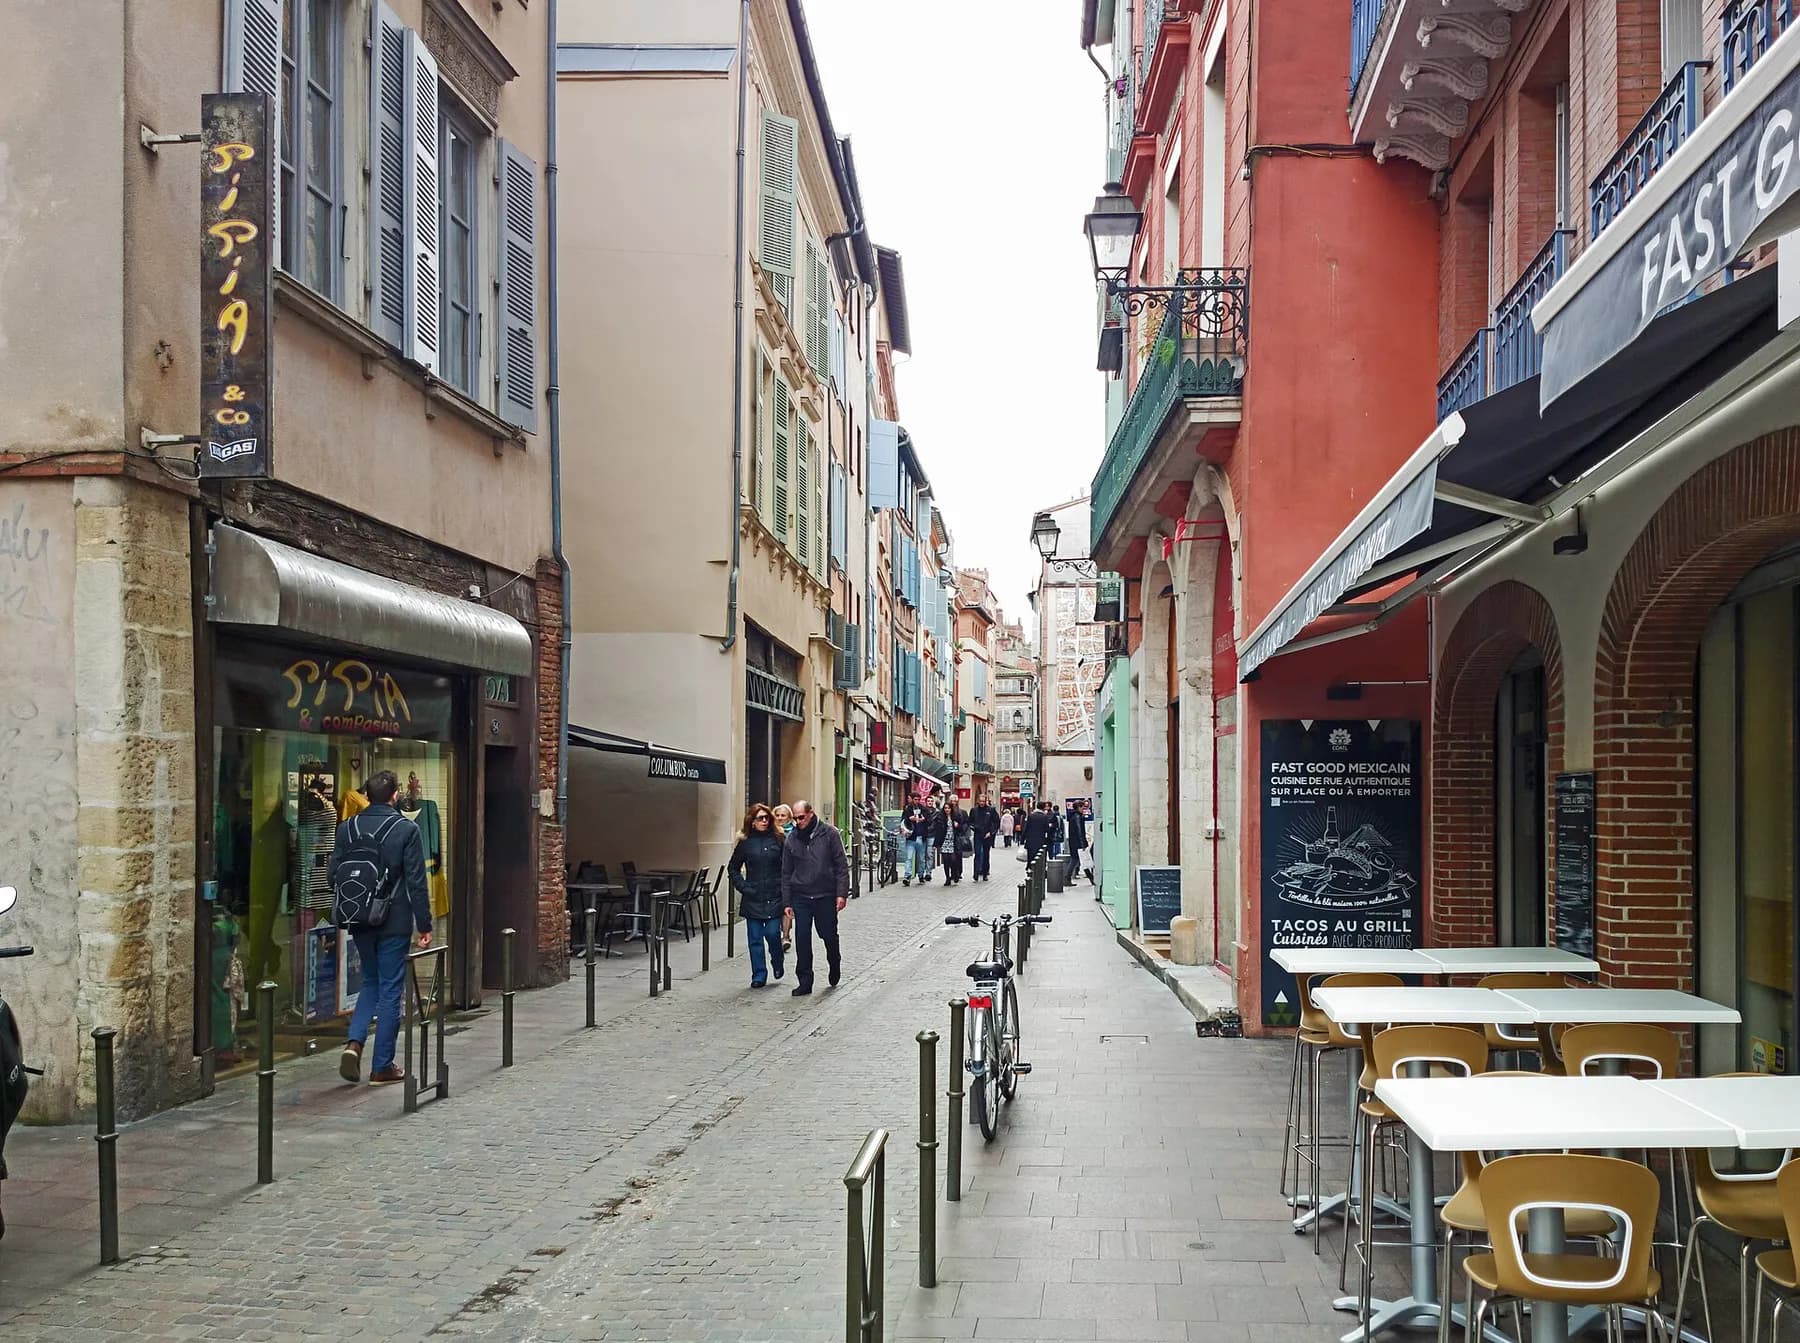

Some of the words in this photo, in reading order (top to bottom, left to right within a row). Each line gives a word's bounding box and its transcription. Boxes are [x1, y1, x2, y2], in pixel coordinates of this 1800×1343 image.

[1641, 155, 1738, 321] FAST
[223, 385, 245, 401] &
[222, 441, 254, 459] GAS
[651, 757, 687, 777] COLUMBUS
[1271, 762, 1304, 774] FAST
[1306, 762, 1345, 774] GOOD
[1348, 763, 1411, 774] MEXICAIN
[1271, 777, 1307, 786] CUISINE
[1308, 777, 1322, 786] DE
[1324, 777, 1342, 786] RUE
[1343, 777, 1411, 787] AUTHENTIQUE
[1271, 788, 1290, 796] SUR
[1294, 788, 1325, 796] PLACE
[1328, 788, 1343, 796] OU
[1357, 788, 1411, 797] EMPORTER
[1271, 919, 1329, 932] TACOS
[1334, 920, 1357, 932] AU
[1363, 920, 1412, 933] GRILL
[1272, 931, 1329, 945] Cuisinés
[1331, 934, 1354, 947] AVEC
[1357, 934, 1373, 947] DES
[1374, 934, 1412, 948] PRODUITS
